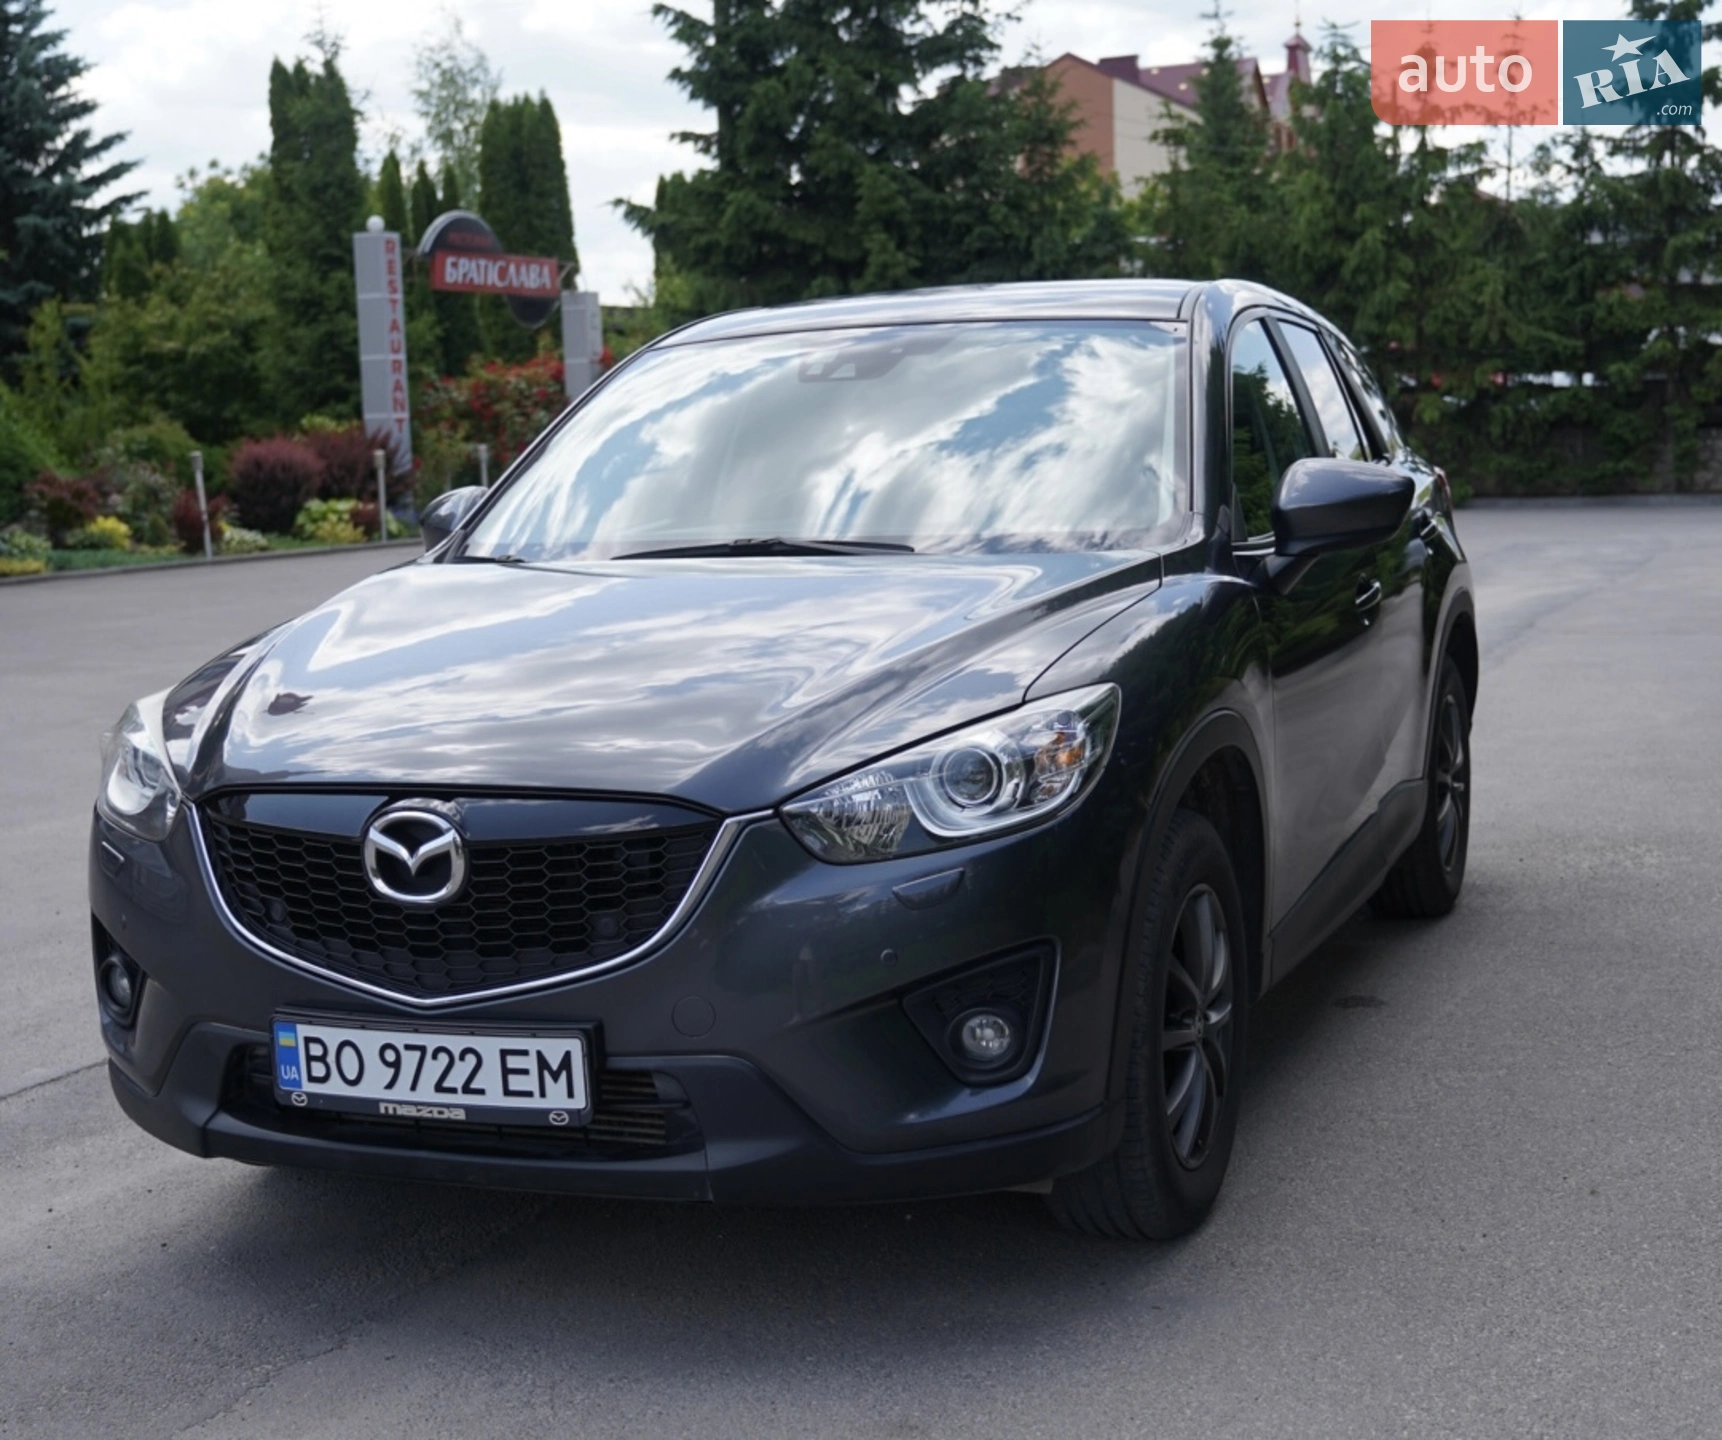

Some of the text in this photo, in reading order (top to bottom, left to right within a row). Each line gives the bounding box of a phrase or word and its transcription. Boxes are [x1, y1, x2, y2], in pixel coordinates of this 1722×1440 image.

[444, 255, 551, 290] БРАТІСЛАВА
[384, 237, 406, 434] RESTAURANT
[280, 1064, 300, 1081] UA
[303, 1035, 575, 1099] BO 9722 EM
